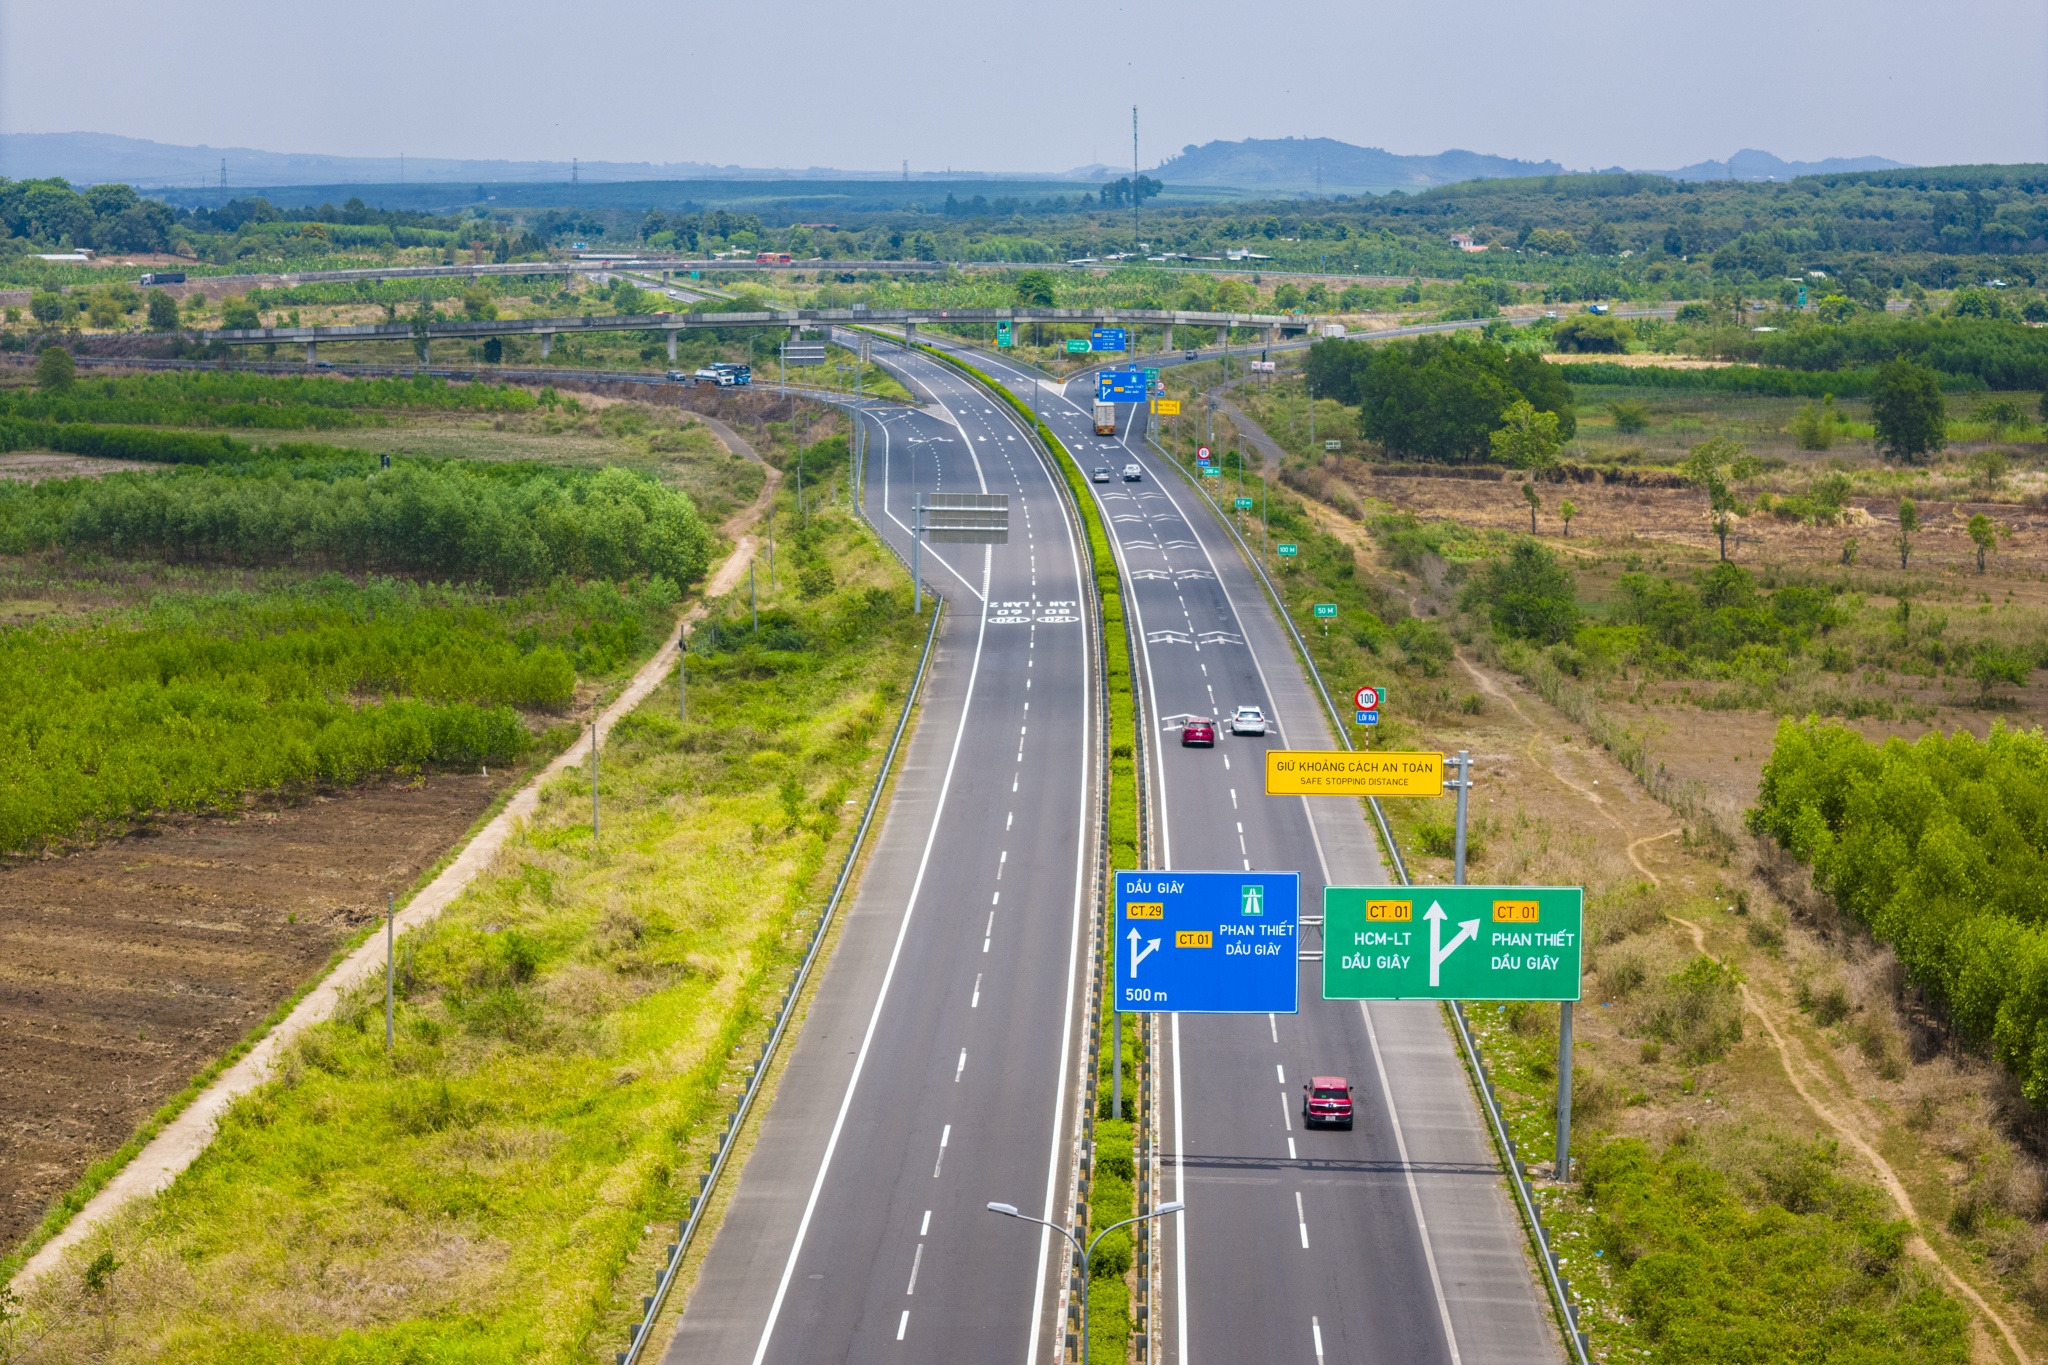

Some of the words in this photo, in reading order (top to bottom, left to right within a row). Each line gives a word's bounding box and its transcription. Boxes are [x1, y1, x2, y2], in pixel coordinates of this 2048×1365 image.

[1360, 694, 1374, 704] 100
[1277, 760, 1296, 772] GIỮ
[1299, 759, 1345, 772] KHOẢNG
[1348, 760, 1378, 772] CÁCH
[1382, 763, 1398, 772] AN
[1402, 760, 1433, 773] TOÀN
[1326, 778, 1366, 786] STOPPING
[1368, 778, 1408, 786] DISTANCE
[1126, 878, 1152, 894] DẦU
[1157, 880, 1184, 894] GIÂY
[1130, 905, 1162, 917] CT.29
[1220, 924, 1254, 936] PHAN
[1259, 920, 1294, 936] THIẾT
[1354, 932, 1412, 946] HCM-LT
[1492, 933, 1532, 946] PHAN
[1534, 929, 1574, 947] THIẾT
[1226, 940, 1250, 956] DẦU
[1254, 942, 1281, 956] GIÂY
[1342, 952, 1370, 969] DẦU
[1376, 954, 1410, 969] GIÂY
[1491, 953, 1520, 970] DẦU
[1526, 955, 1559, 970] GIÂY
[1126, 988, 1150, 1002] 500
[1154, 991, 1168, 1002] m
